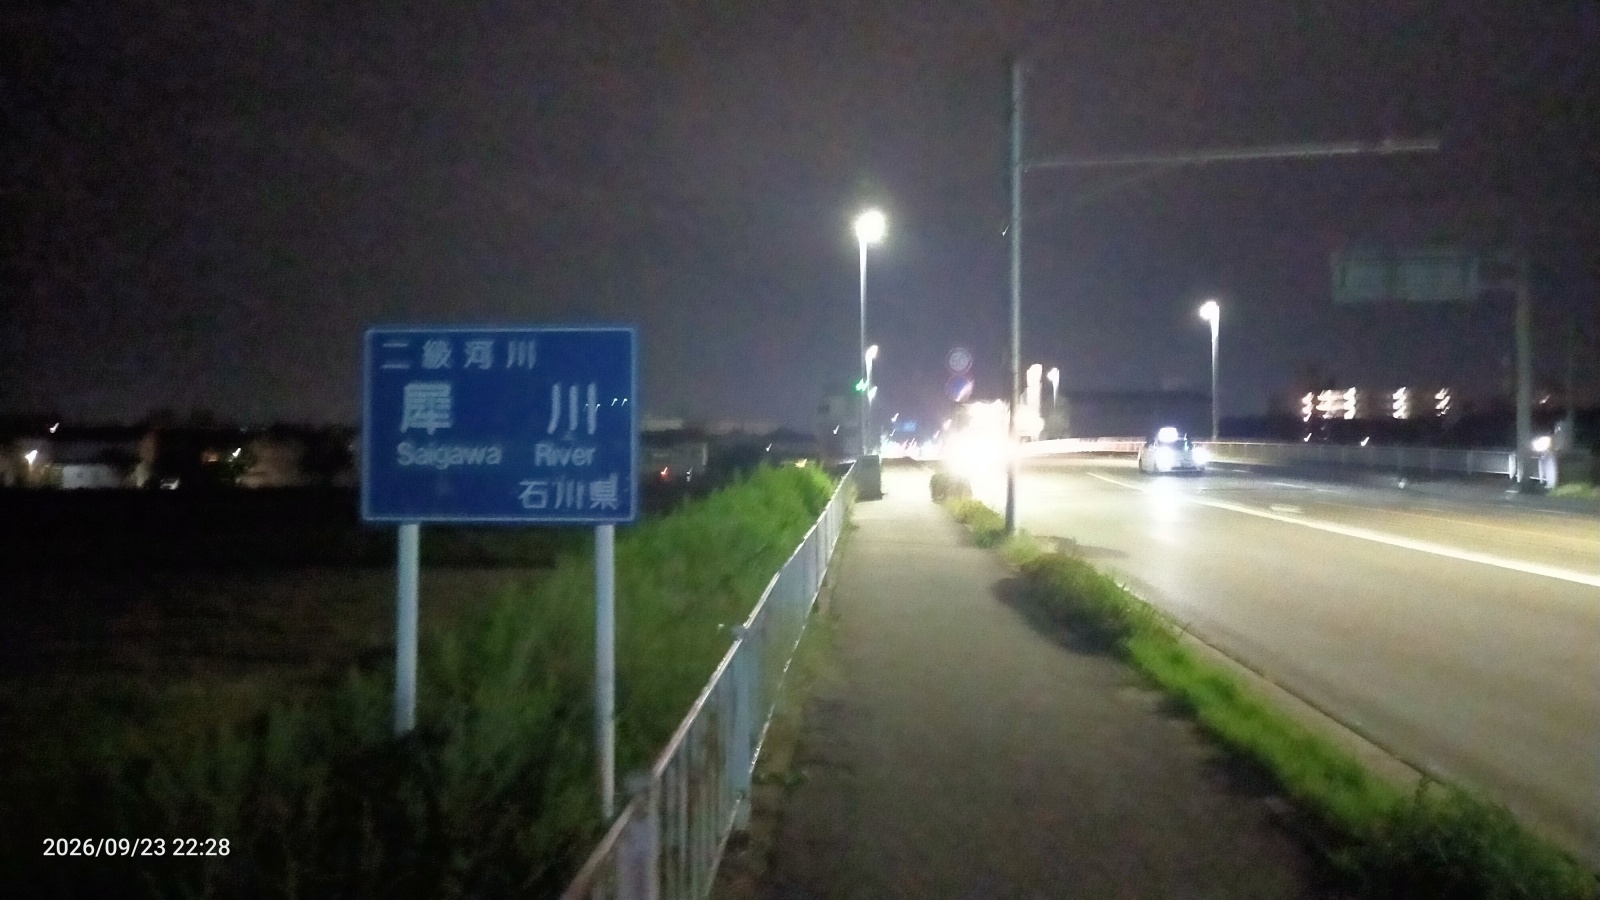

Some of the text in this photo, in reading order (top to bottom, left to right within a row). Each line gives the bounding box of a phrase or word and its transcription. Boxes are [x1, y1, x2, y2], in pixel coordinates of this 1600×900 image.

[380, 339, 537, 369] 二級河川
[397, 442, 596, 470] Saigawa River
[518, 473, 619, 510] 石川県
